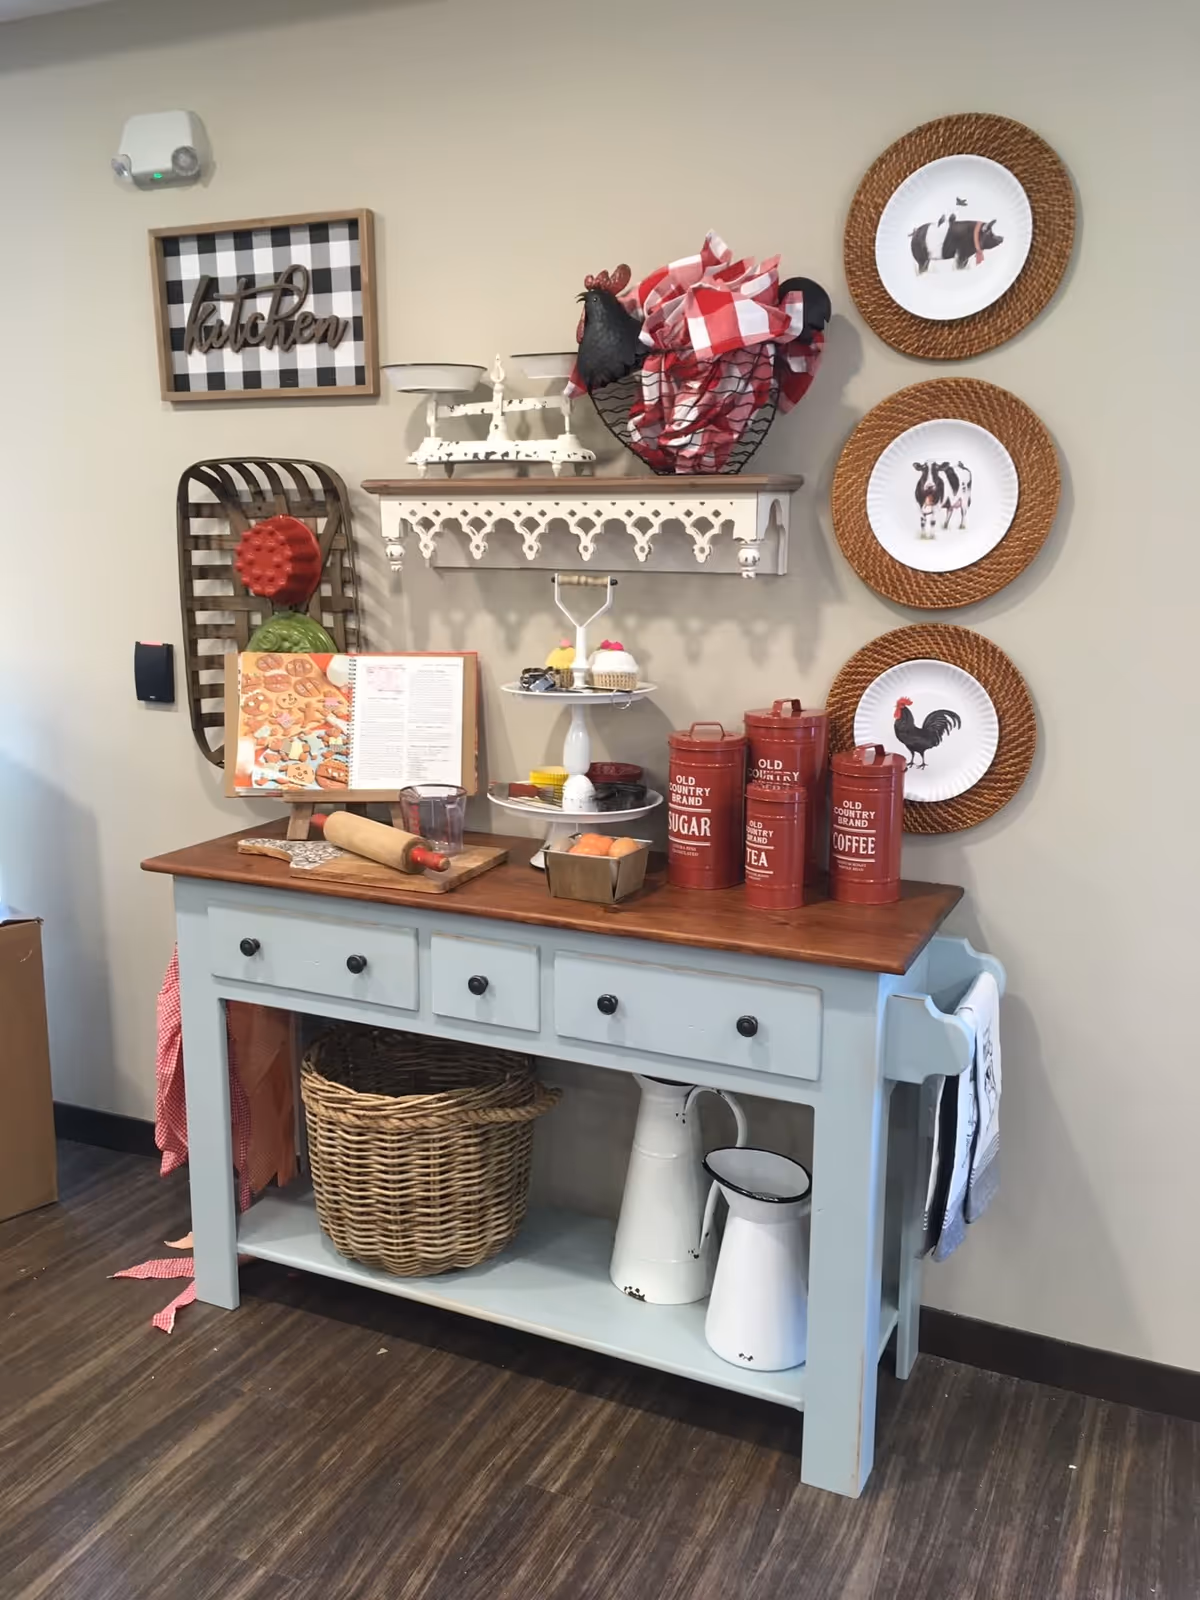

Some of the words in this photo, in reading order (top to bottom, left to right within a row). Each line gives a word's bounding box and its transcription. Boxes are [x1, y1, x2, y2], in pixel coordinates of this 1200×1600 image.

[184, 264, 349, 355] kitchen
[758, 759, 783, 770] OLD
[676, 775, 696, 786] OLD
[670, 783, 711, 797] COUNTRY
[672, 793, 703, 806] BRAND
[843, 800, 862, 810] OLD
[834, 807, 876, 820] COUNTRY
[668, 811, 711, 837] SUGAR
[749, 820, 763, 829] OLD
[838, 816, 869, 828] BRAND
[833, 831, 876, 855] COFFEE
[746, 847, 769, 868] TEA
